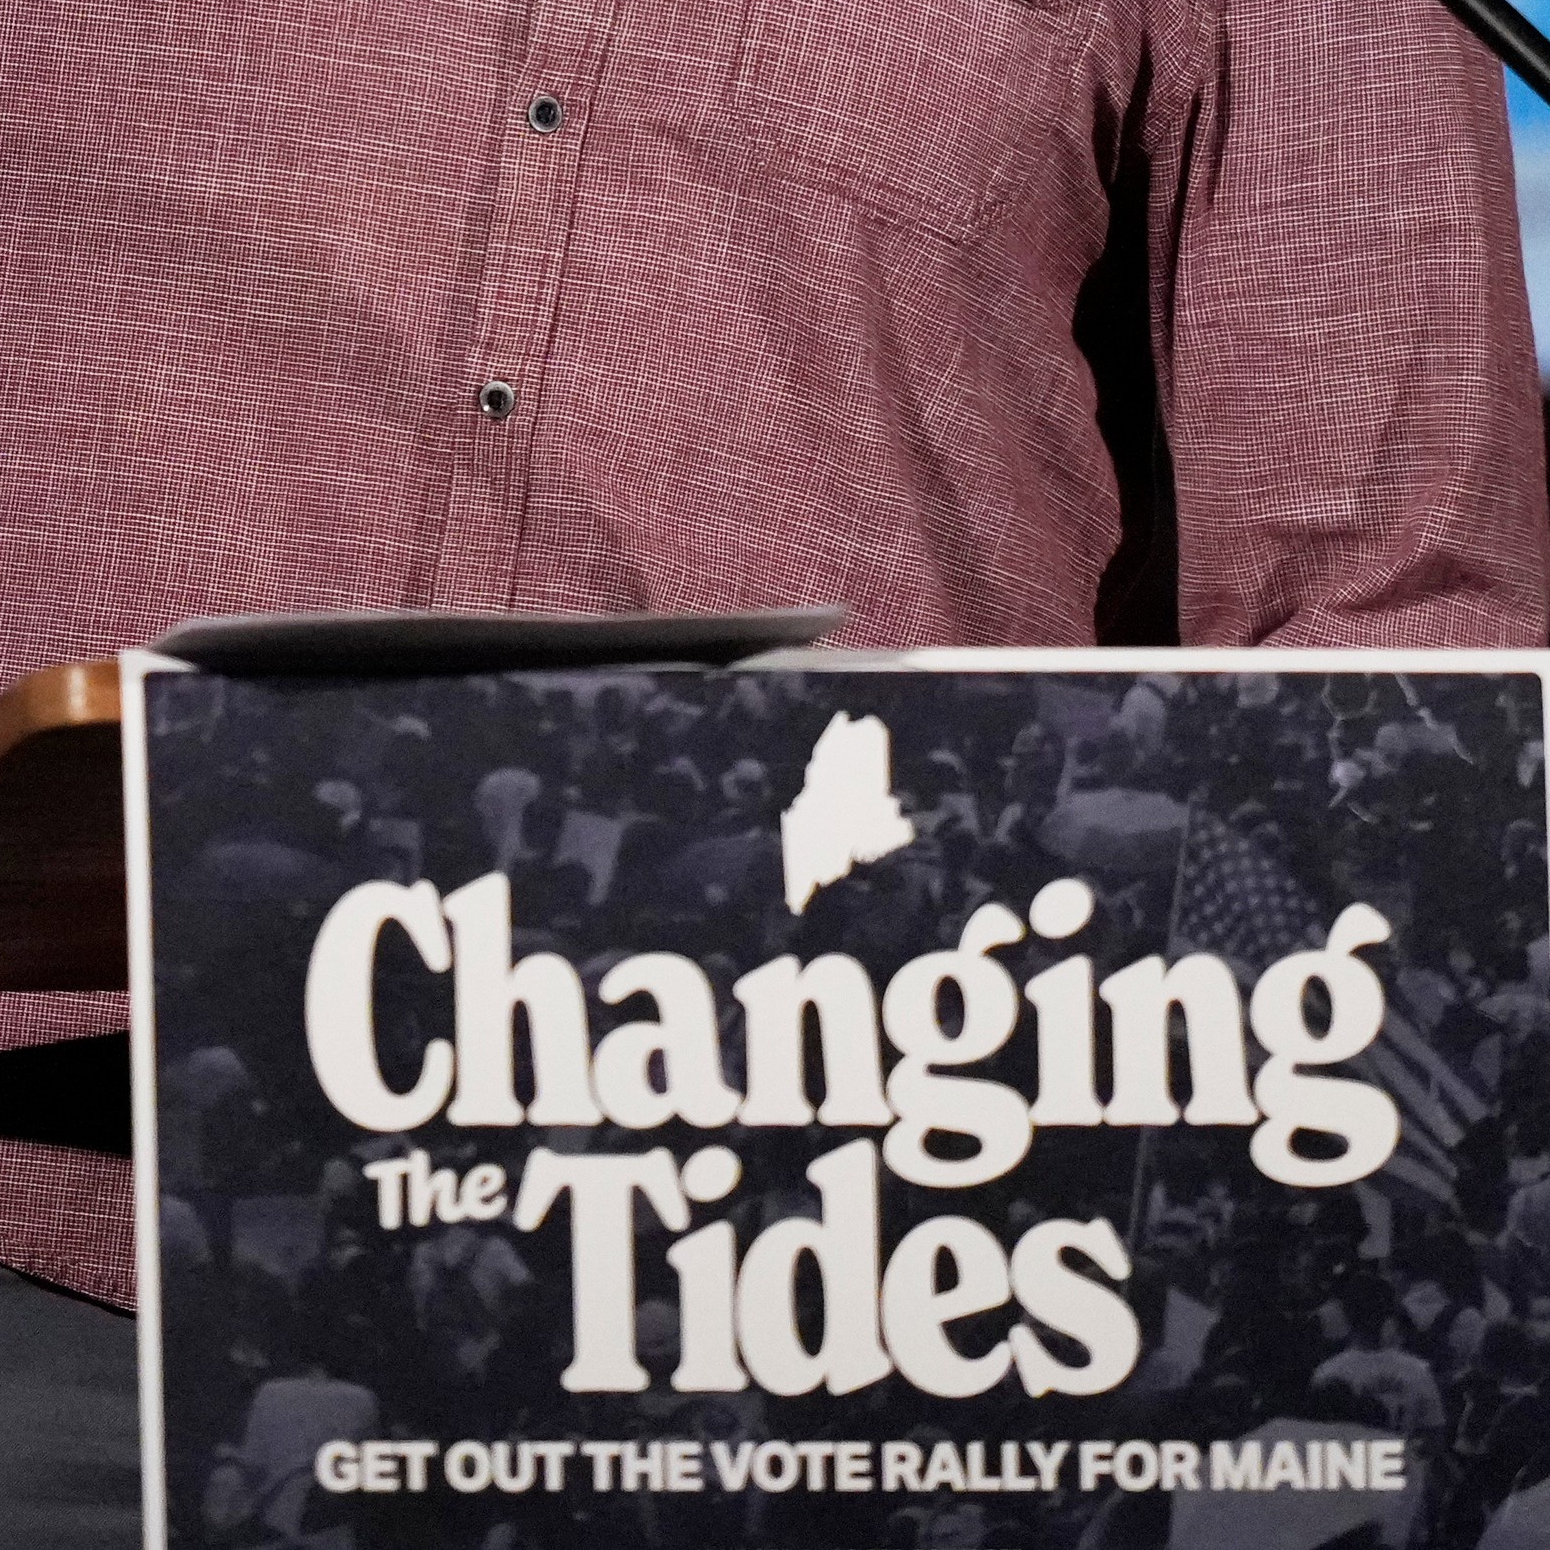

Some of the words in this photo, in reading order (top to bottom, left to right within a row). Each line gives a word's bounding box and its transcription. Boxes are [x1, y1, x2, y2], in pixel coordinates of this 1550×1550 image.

[304, 871, 1400, 1188] Changing
[364, 1148, 508, 1230] The
[513, 1138, 1141, 1399] Tides
[314, 1439, 438, 1493] GET
[443, 1440, 575, 1493] OUT
[579, 1440, 704, 1492] THE
[709, 1440, 873, 1493] VOTE
[881, 1440, 1070, 1492] RALLY
[1078, 1440, 1202, 1492] FOR
[1208, 1439, 1407, 1493] MAINE
